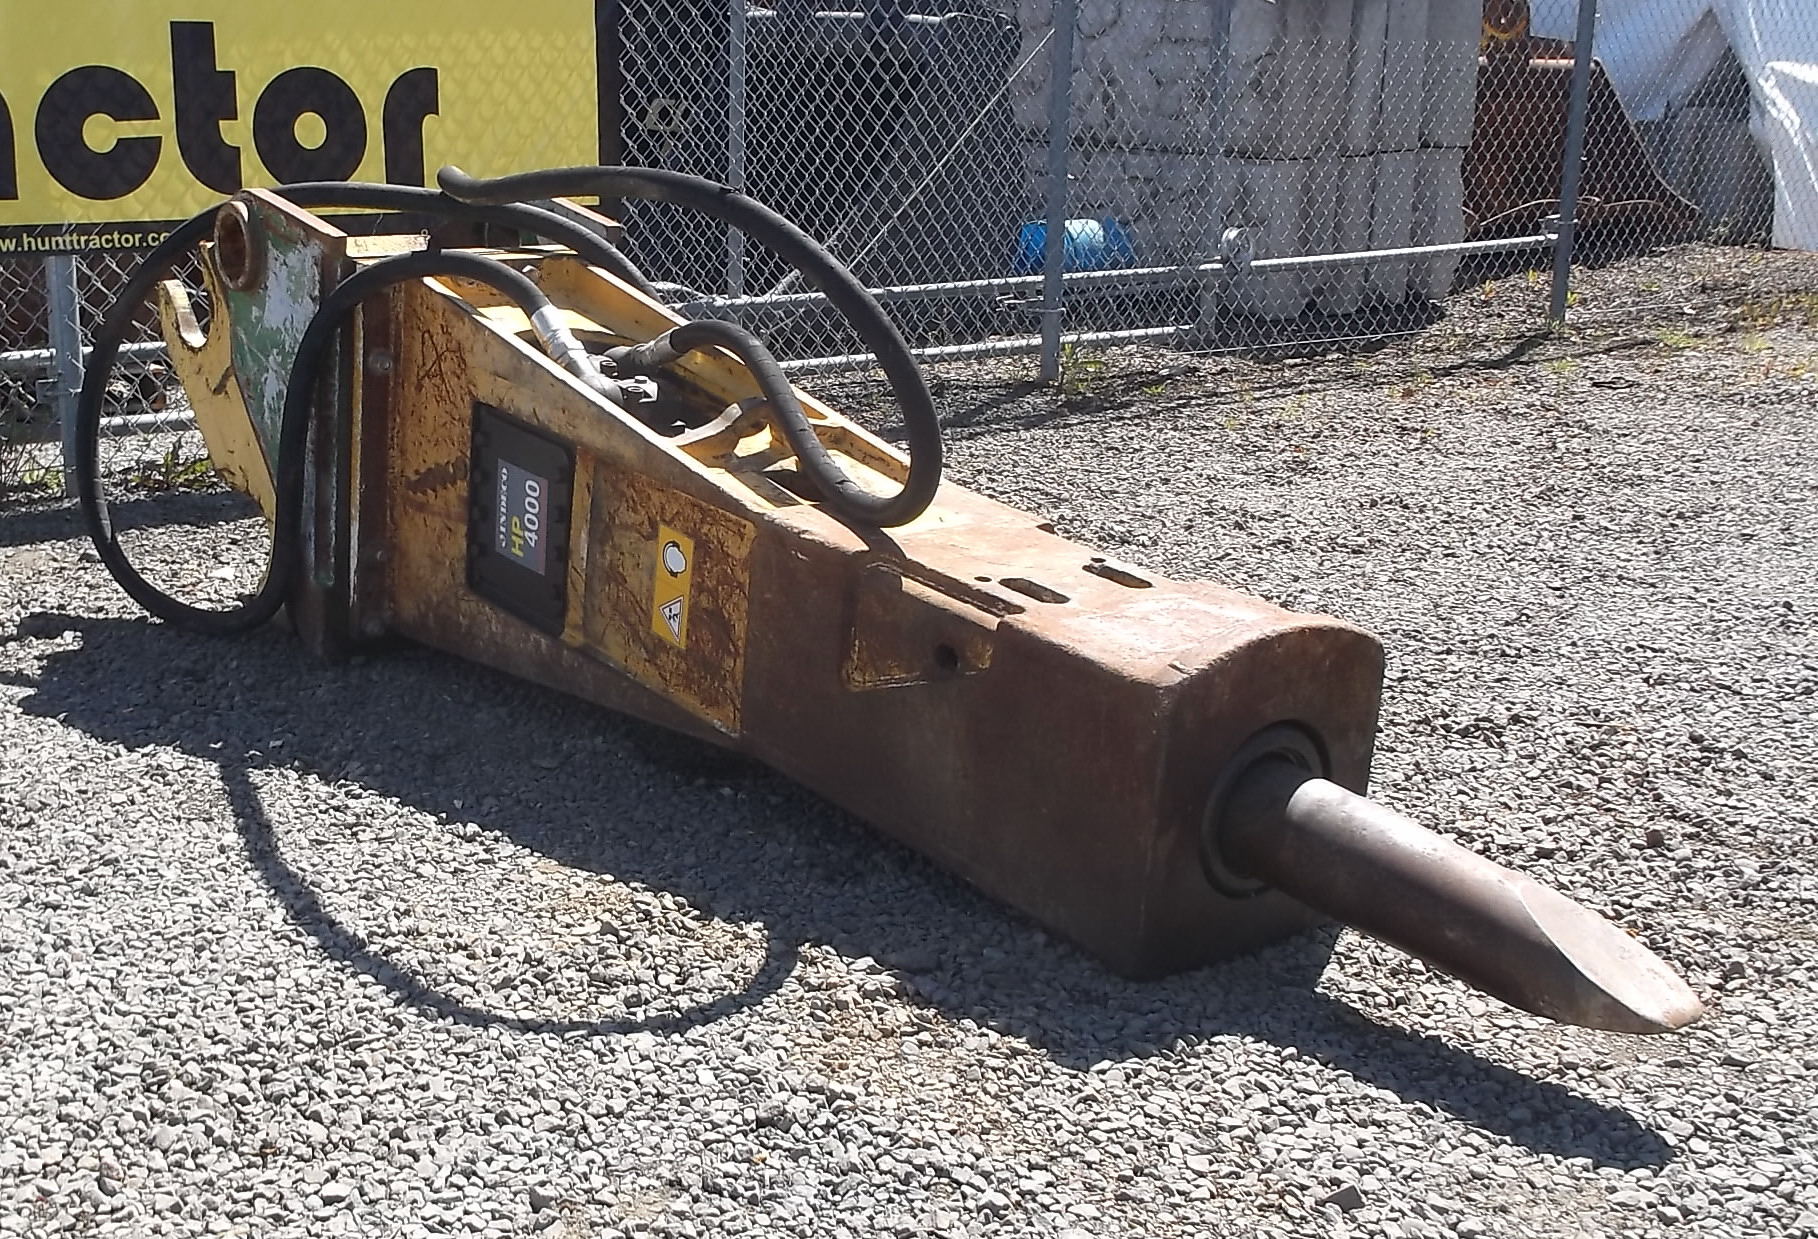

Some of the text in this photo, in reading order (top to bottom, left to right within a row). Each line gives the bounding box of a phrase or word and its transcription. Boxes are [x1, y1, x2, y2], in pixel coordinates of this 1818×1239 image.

[0, 20, 440, 200] ctor
[511, 516, 525, 557] HP
[524, 480, 540, 547] 4000
